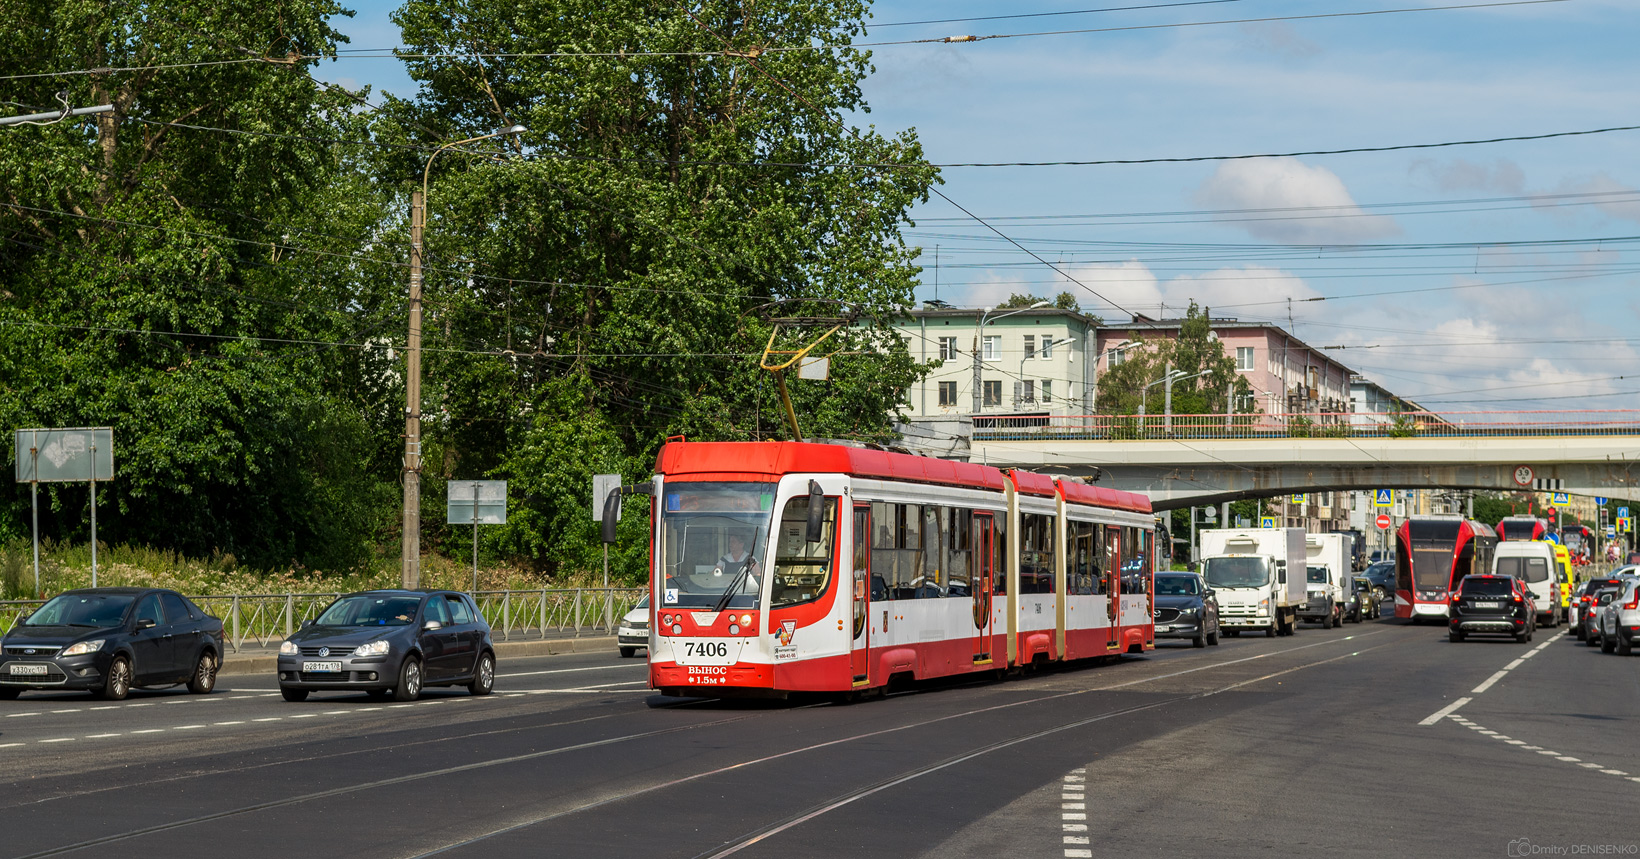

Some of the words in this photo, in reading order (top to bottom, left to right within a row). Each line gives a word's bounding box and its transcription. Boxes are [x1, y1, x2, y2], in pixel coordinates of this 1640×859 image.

[685, 642, 727, 657] 7406
[688, 666, 727, 674] ВЫНОС
[696, 676, 717, 684] 1.5м
